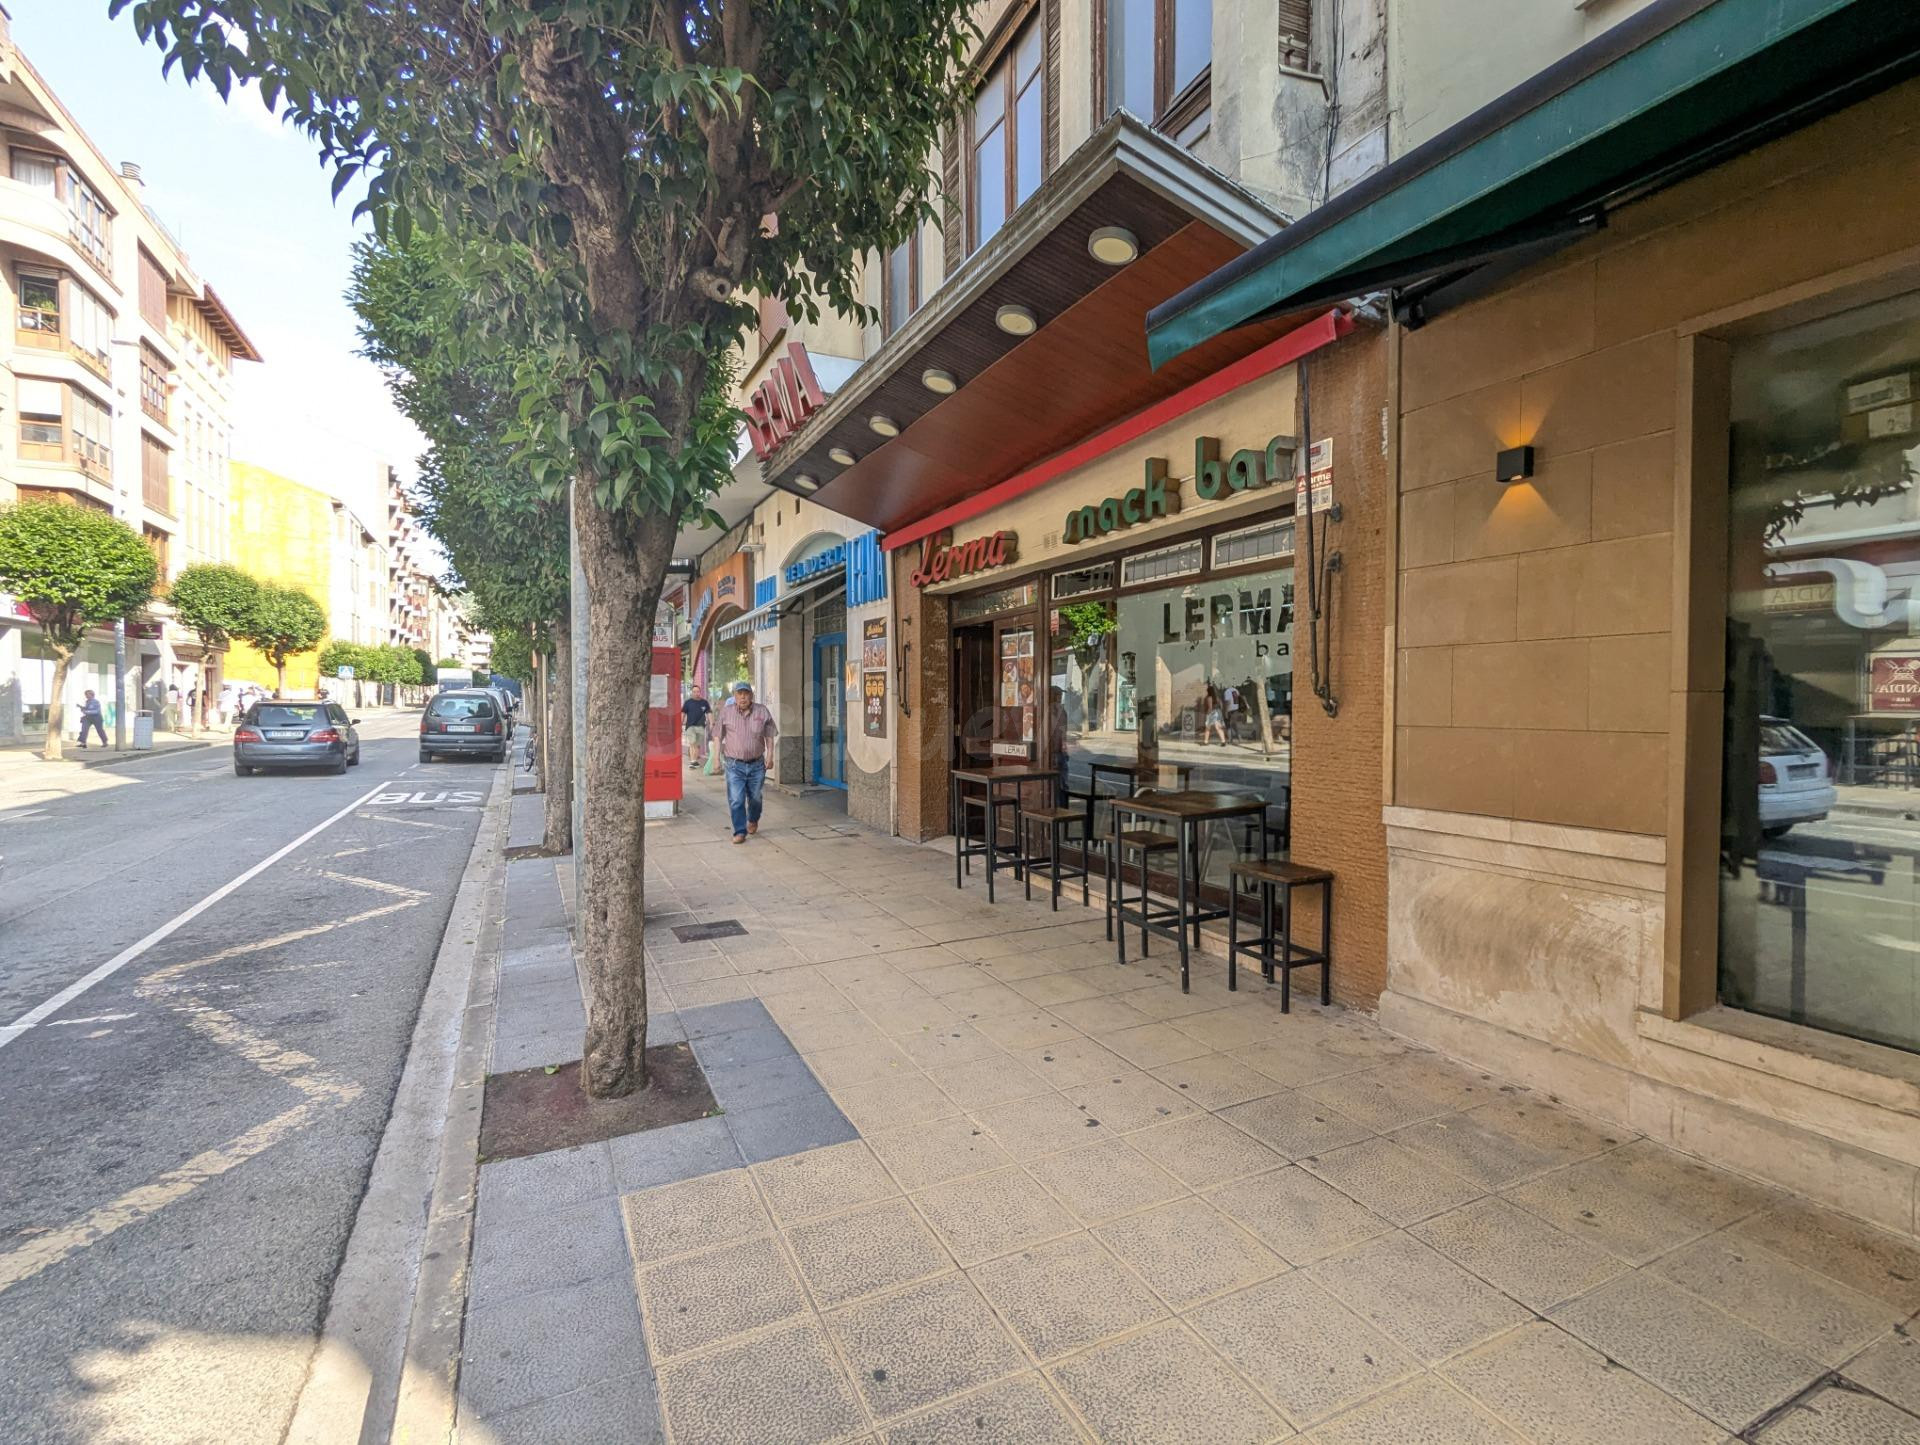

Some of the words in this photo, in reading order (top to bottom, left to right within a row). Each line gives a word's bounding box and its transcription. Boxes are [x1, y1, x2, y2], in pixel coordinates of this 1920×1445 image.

[743, 341, 825, 463] LERMA
[1063, 458, 1180, 544] snack
[1196, 435, 1298, 500] bar
[910, 530, 1016, 588] Lerma
[366, 791, 484, 805] BUS
